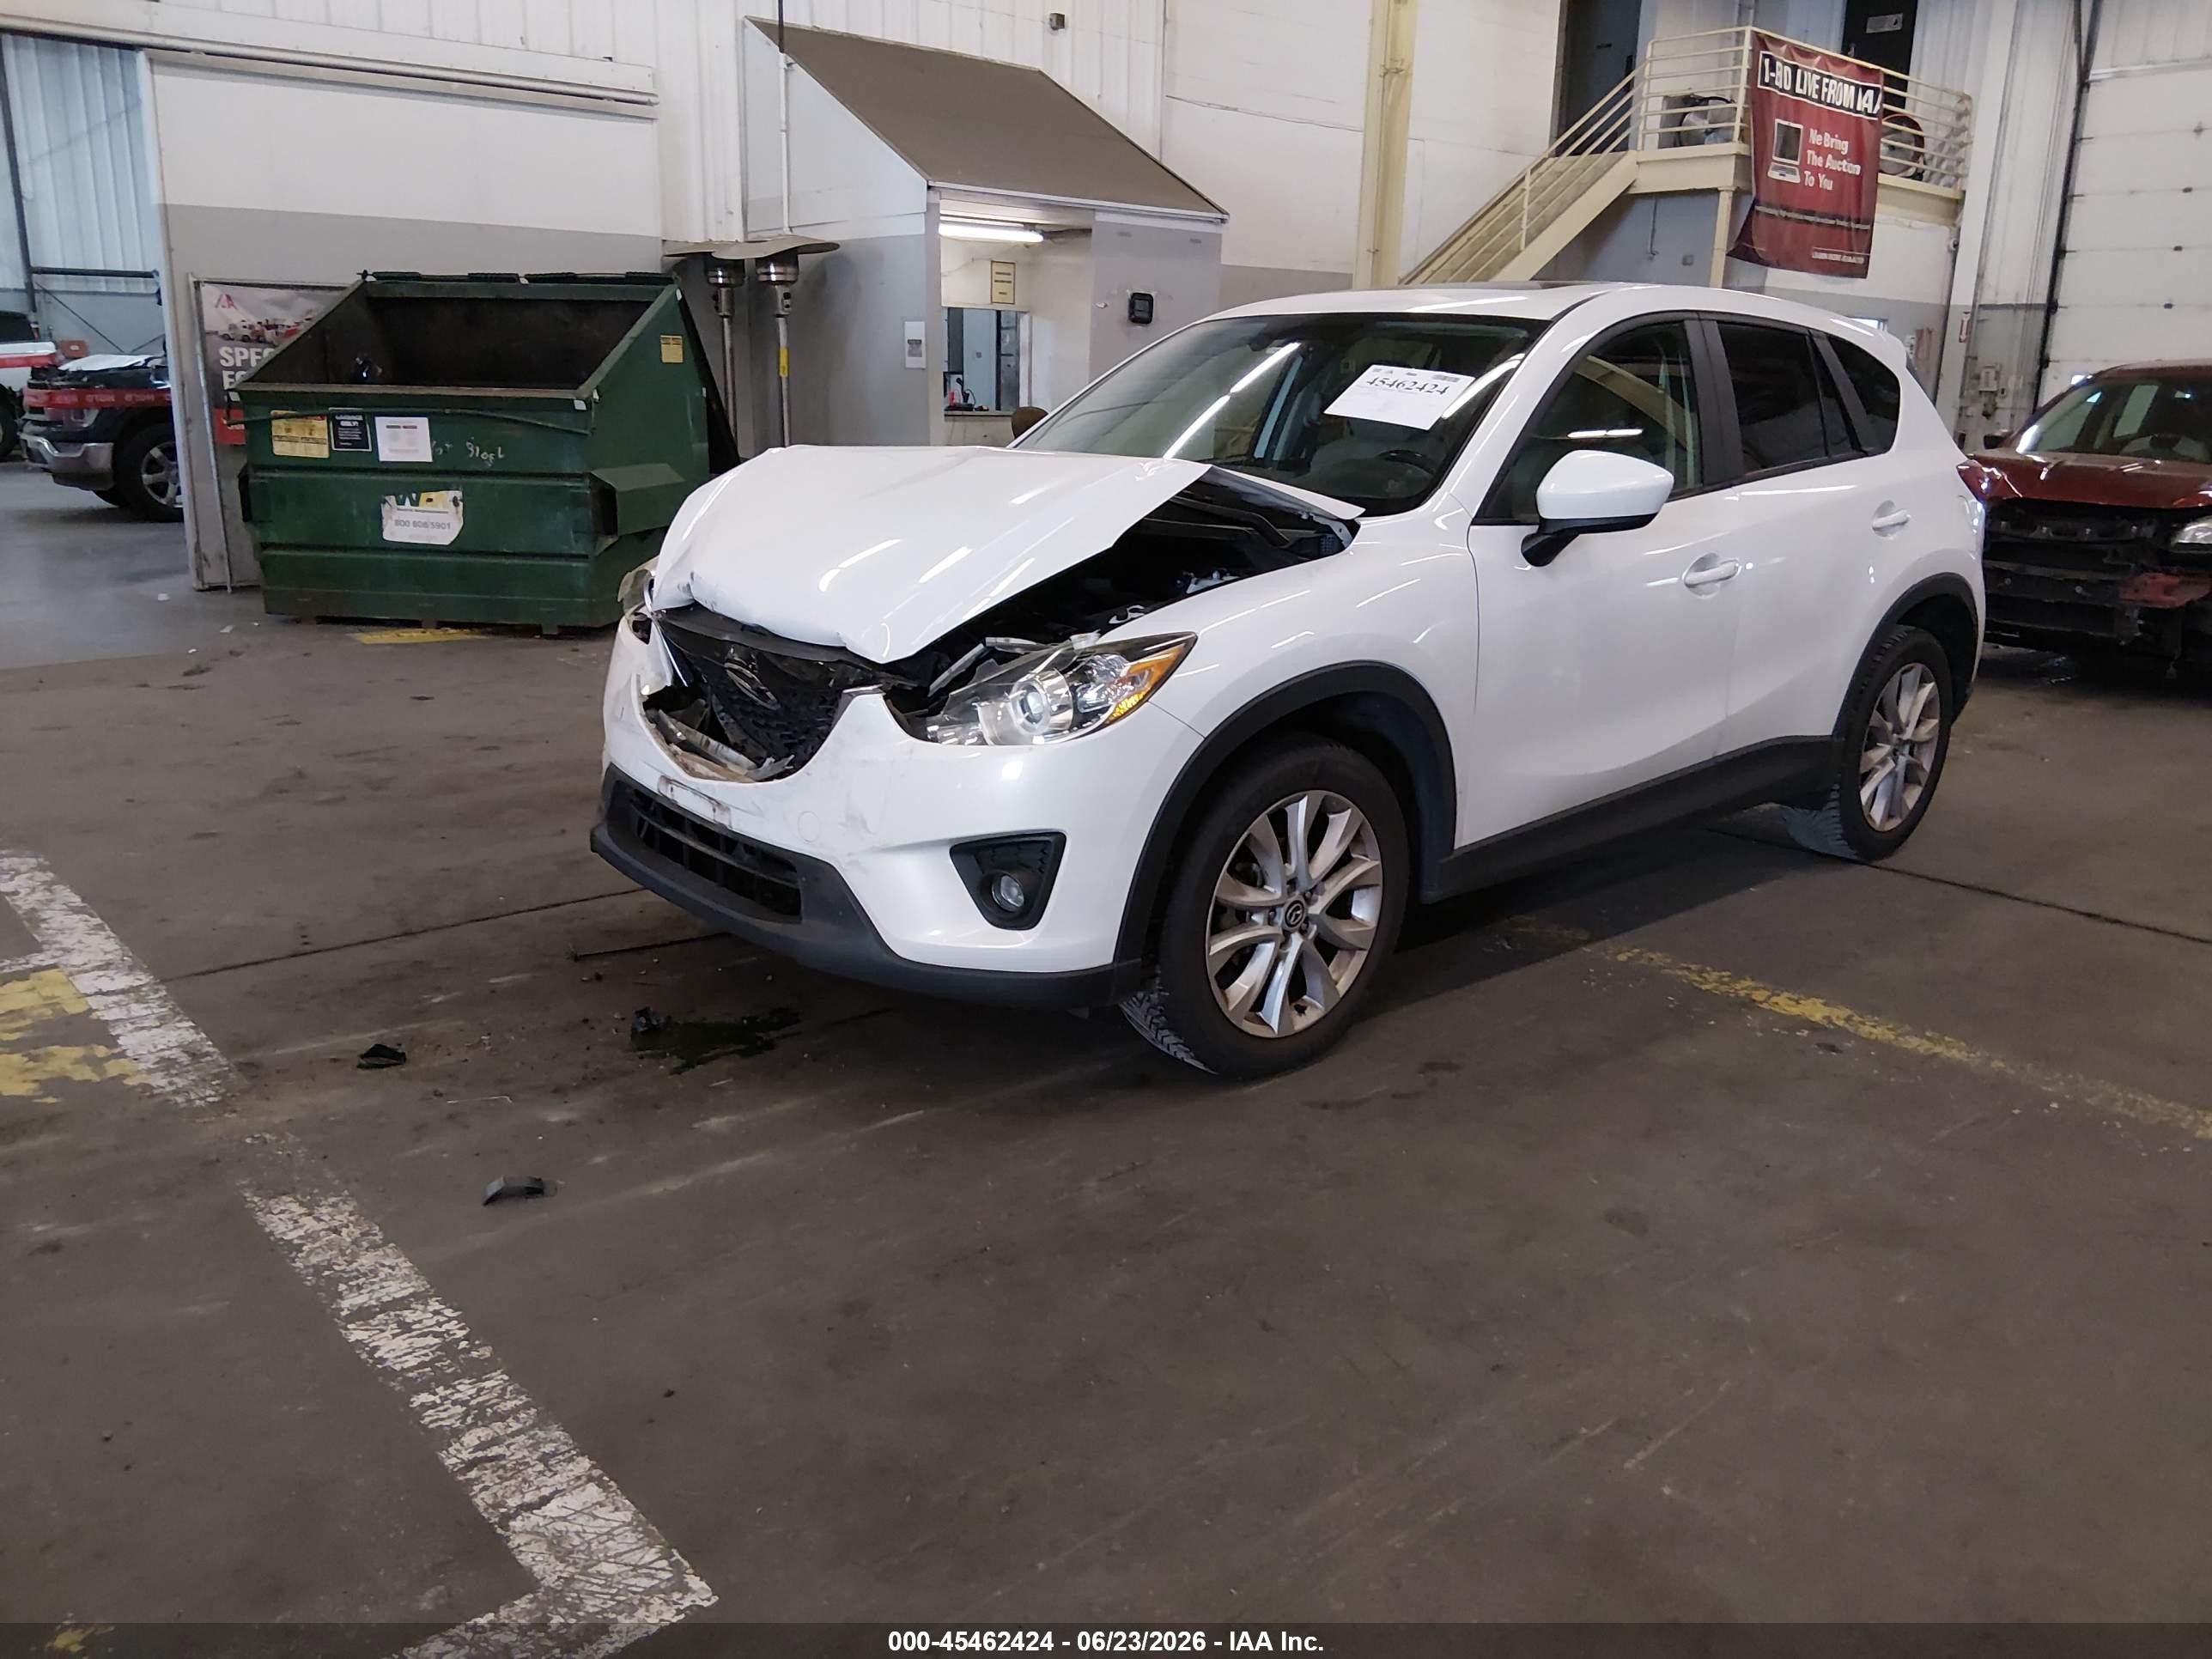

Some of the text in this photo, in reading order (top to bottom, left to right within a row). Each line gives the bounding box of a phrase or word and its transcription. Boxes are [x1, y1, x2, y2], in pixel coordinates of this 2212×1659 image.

[1795, 68, 1821, 100] LIVE
[1820, 76, 1856, 110] FROM
[1806, 149, 1824, 167] The
[1803, 170, 1834, 191] To You
[1366, 377, 1449, 394] 45462424
